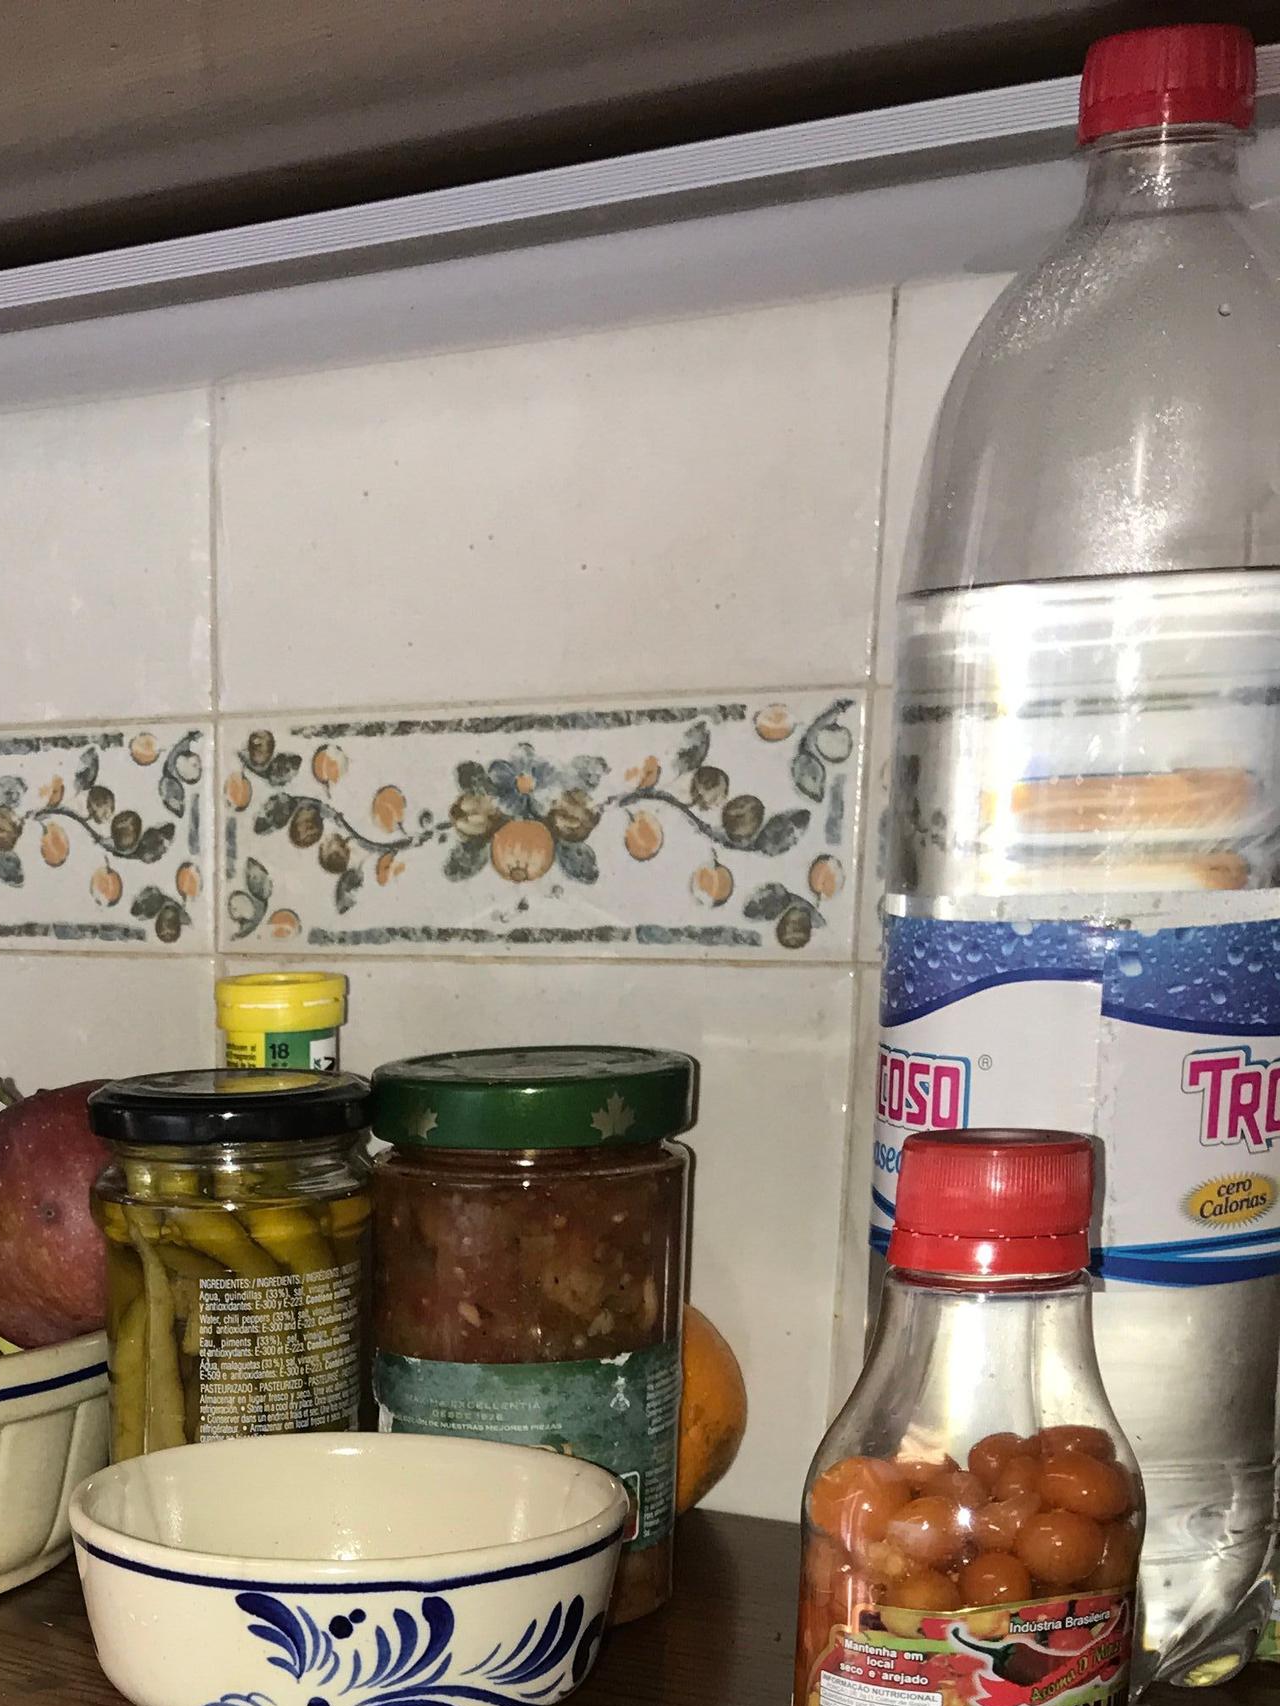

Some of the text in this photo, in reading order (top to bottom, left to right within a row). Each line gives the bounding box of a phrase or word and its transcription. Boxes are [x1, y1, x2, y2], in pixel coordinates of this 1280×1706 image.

[269, 1043, 290, 1060] 18
[1217, 1177, 1253, 1197] cero
[224, 1290, 263, 1303] guindillas
[241, 1314, 271, 1326] peppers
[221, 1337, 251, 1348] piments
[200, 1382, 253, 1393] PASTEURIZADO
[440, 1422, 485, 1431] NUESTRAS
[485, 1424, 529, 1432] MEJORES
[1009, 1619, 1062, 1633] Indústria
[844, 1638, 924, 1661] Mantenha em
[866, 1655, 895, 1669] local
[839, 1662, 929, 1685] seco e arejado
